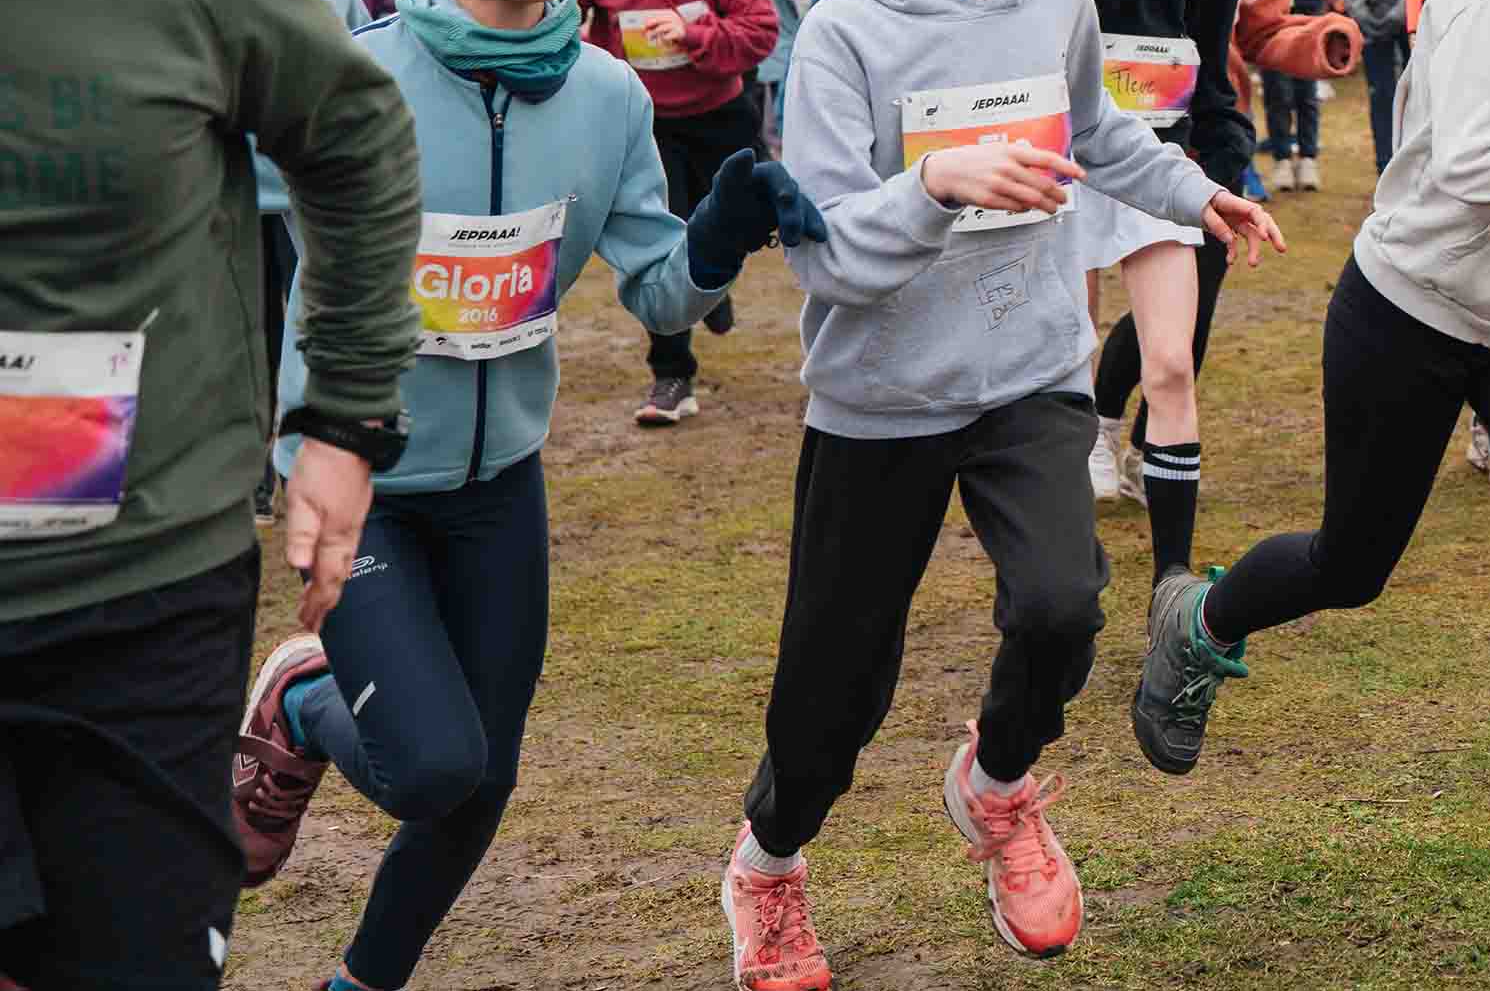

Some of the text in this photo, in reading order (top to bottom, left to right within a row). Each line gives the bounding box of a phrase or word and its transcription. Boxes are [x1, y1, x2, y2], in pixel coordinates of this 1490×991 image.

[970, 91, 1030, 112] JEPPAAA!
[449, 225, 521, 241] JEPPAAA!
[415, 261, 534, 302] Gloria
[459, 307, 498, 324] 2016
